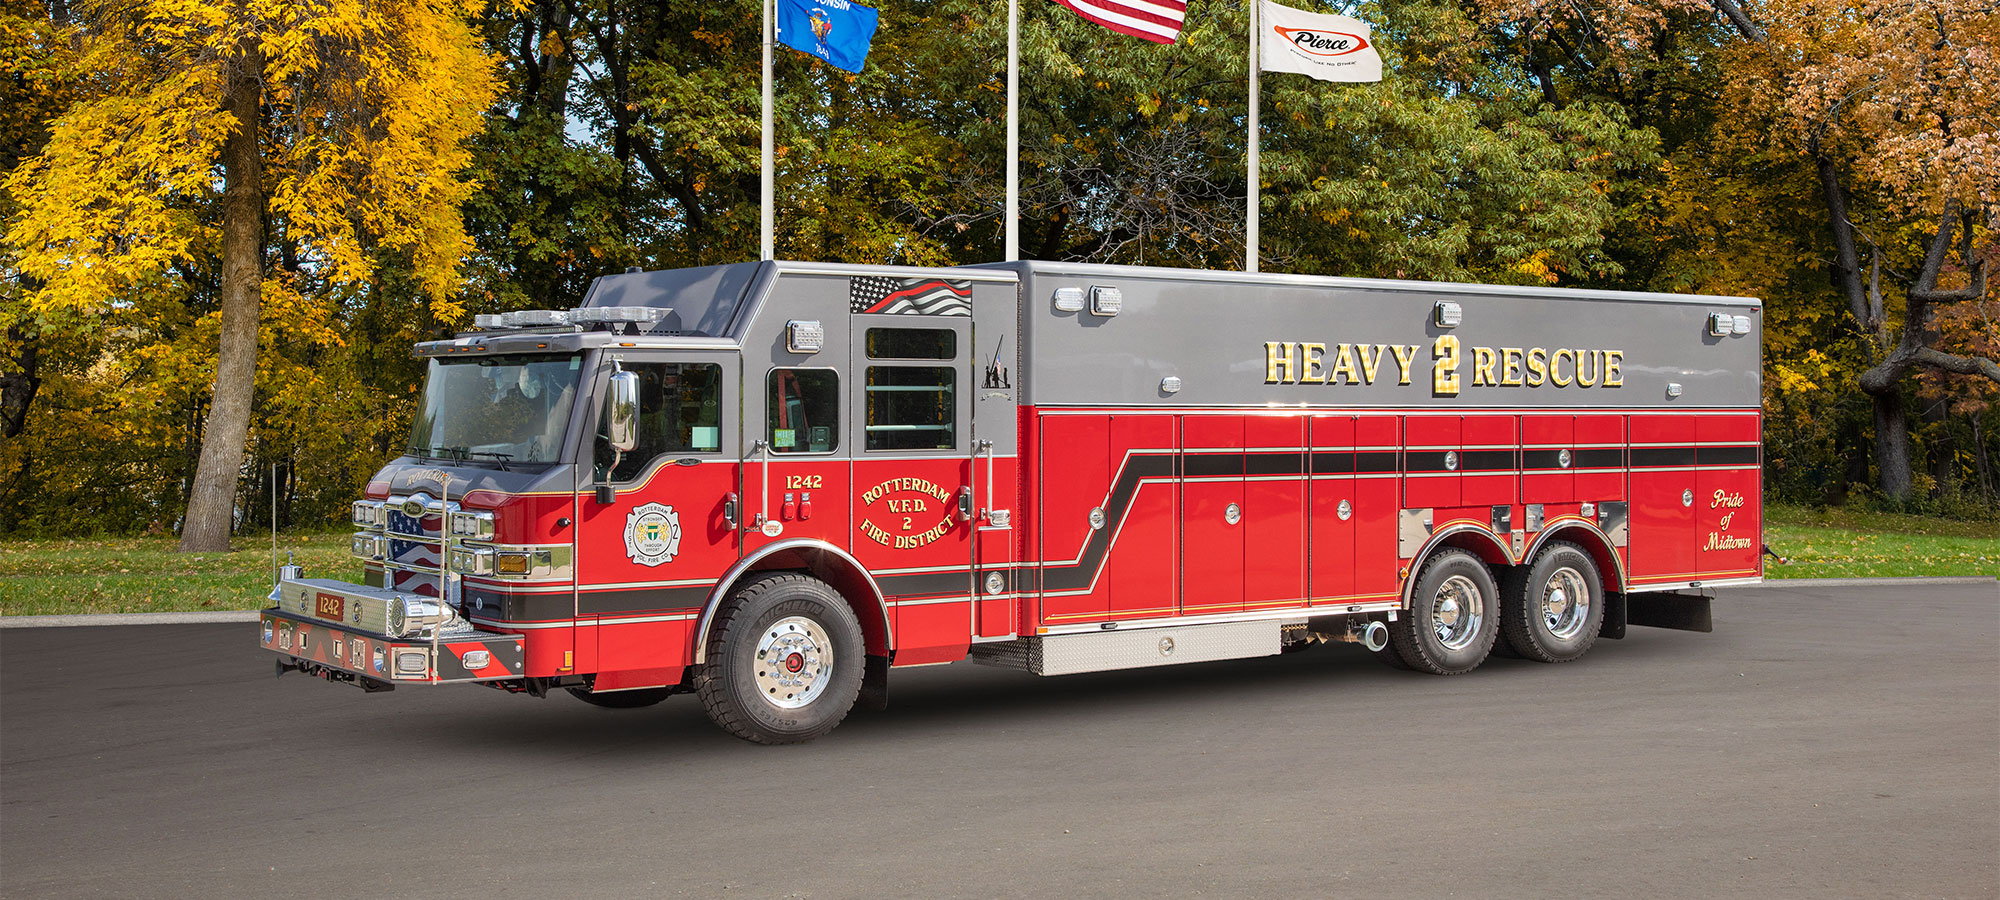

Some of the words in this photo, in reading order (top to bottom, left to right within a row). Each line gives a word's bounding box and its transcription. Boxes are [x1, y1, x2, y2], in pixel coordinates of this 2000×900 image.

[1295, 32, 1349, 50] Pierce
[1264, 341, 1421, 387] HEAVY
[1431, 334, 1461, 398] 2
[1471, 346, 1625, 389] RESCUE
[786, 475, 822, 490] 1242
[862, 477, 951, 507] ROTTERDAM
[1710, 489, 1745, 509] Pride
[672, 523, 679, 540] 2
[859, 518, 891, 547] FIRE
[894, 514, 954, 549] DISTRICT
[901, 517, 912, 531] 2
[1720, 511, 1735, 532] of
[1703, 531, 1752, 552] Midtown
[319, 596, 340, 616] 1242
[759, 601, 827, 628] MICHELIN
